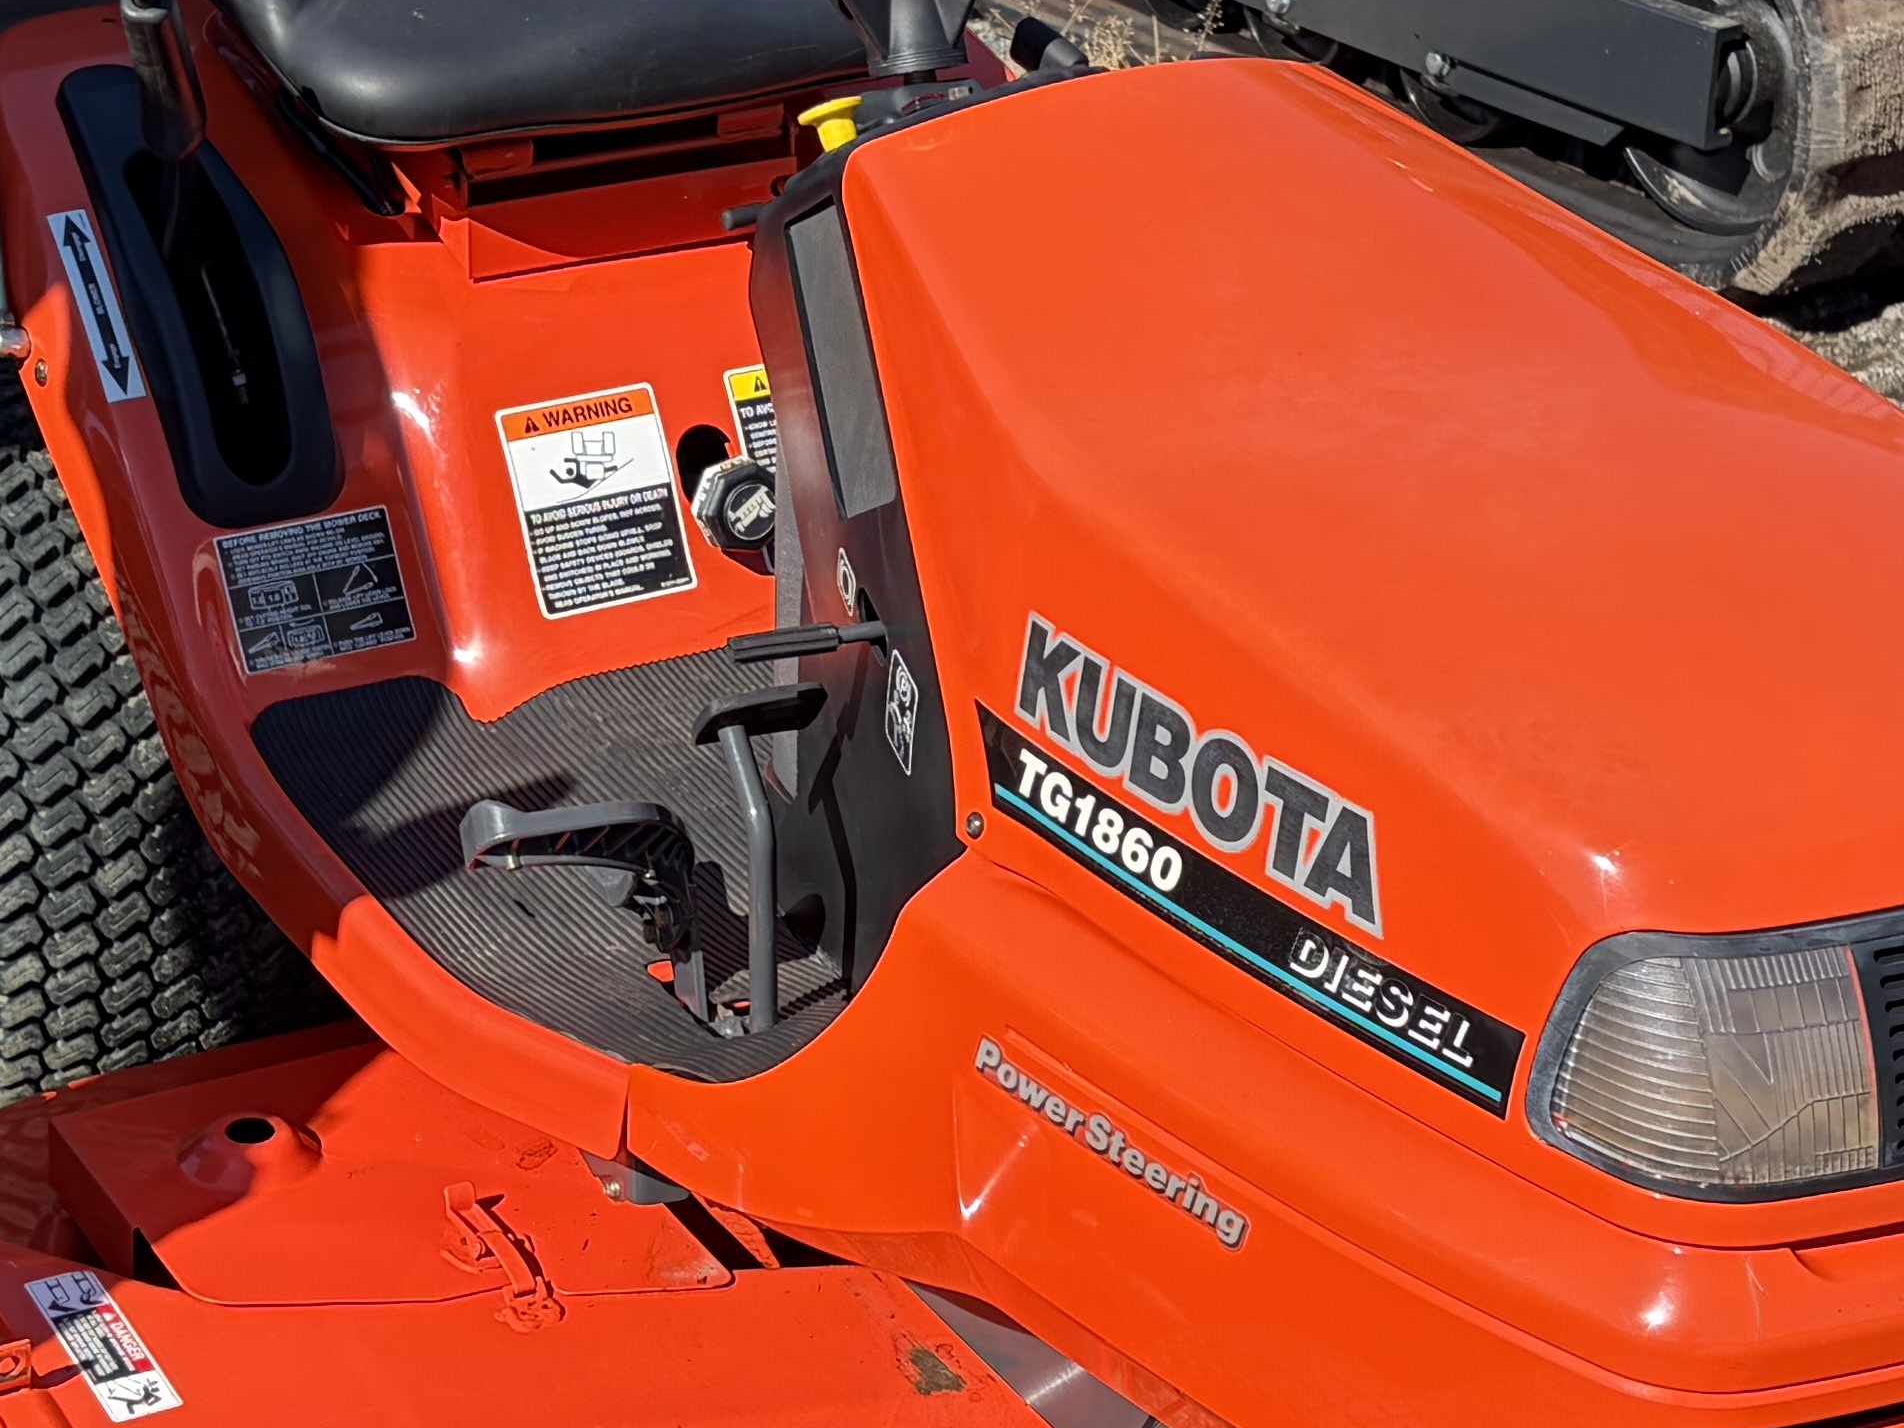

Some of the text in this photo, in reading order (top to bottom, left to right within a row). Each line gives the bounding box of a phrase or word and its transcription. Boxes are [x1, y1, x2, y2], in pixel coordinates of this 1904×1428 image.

[543, 397, 633, 428] WARNING
[304, 521, 322, 533] THE
[1014, 609, 1385, 941] KUBOTA
[1017, 747, 1185, 895] TG1860
[1287, 925, 1476, 1069] DIESEL
[973, 1034, 1249, 1252] Power Steering
[110, 1322, 145, 1361] DANGER
